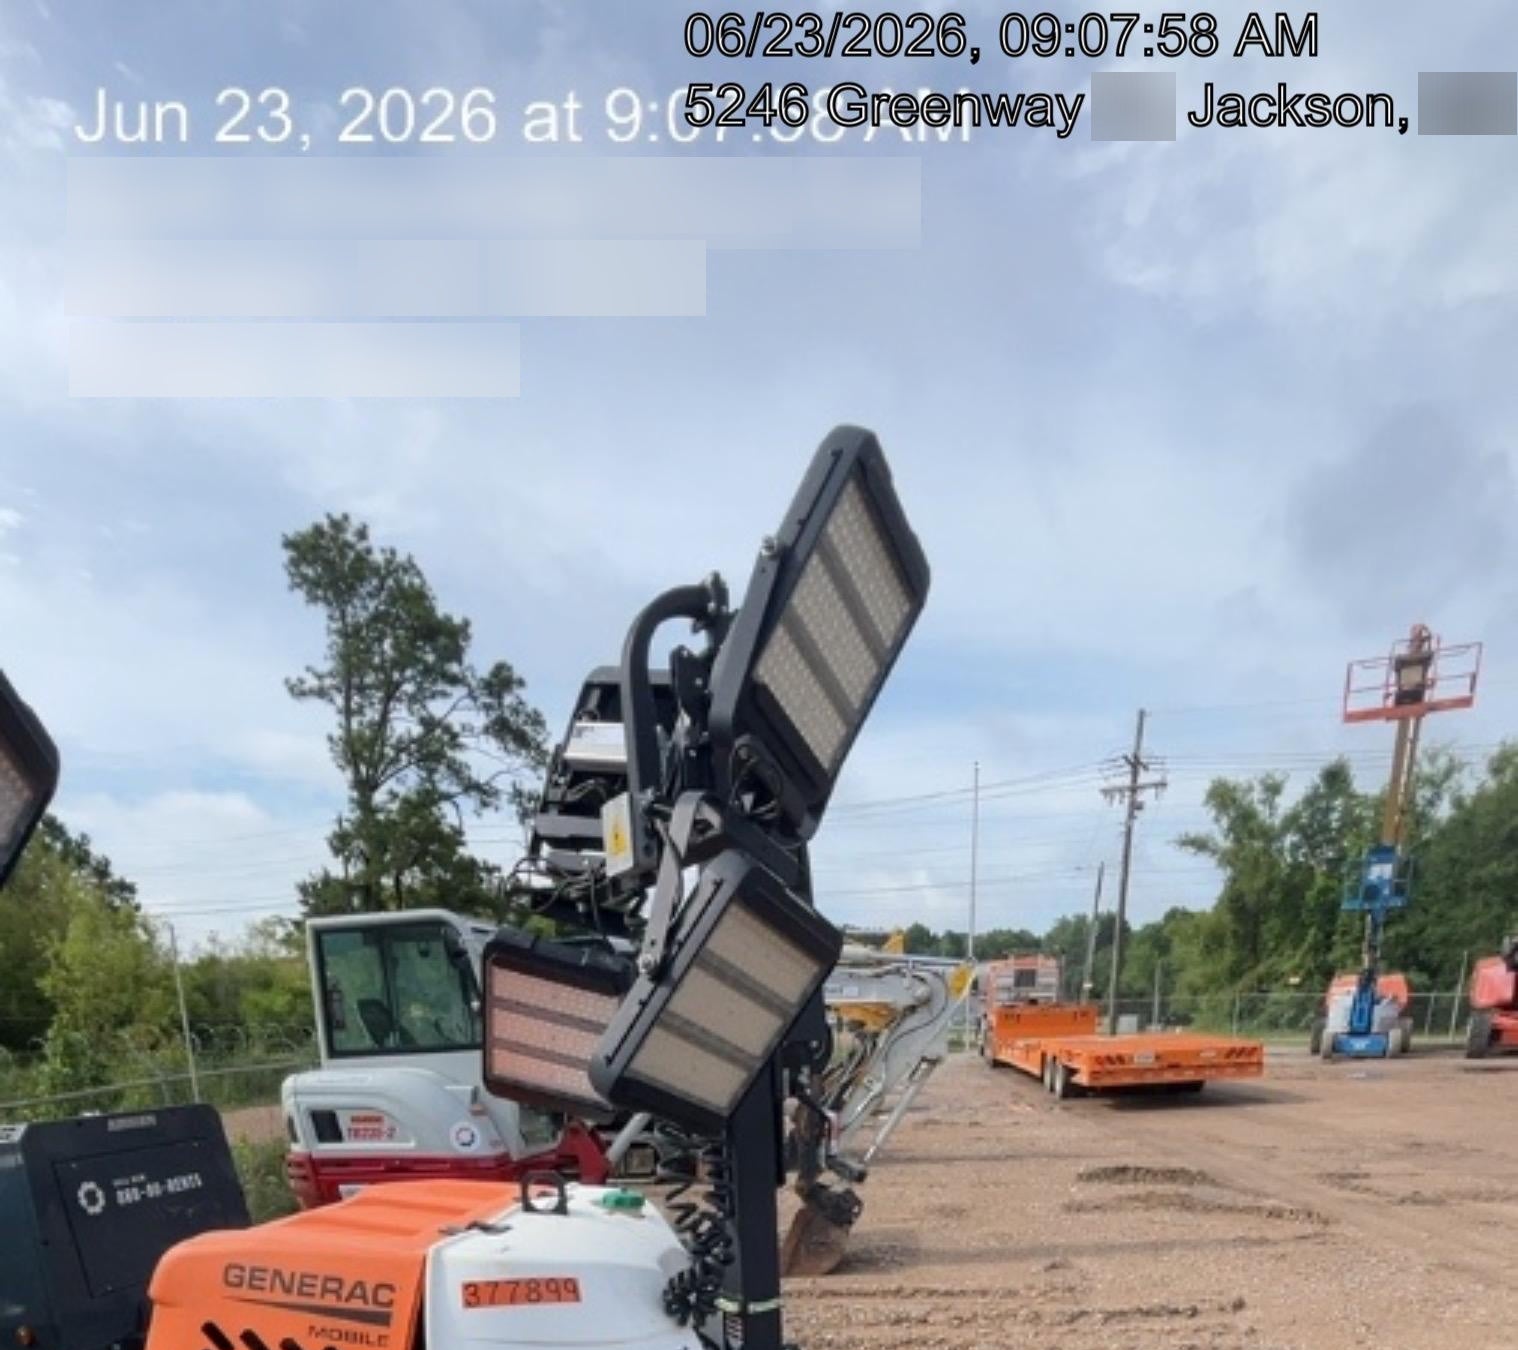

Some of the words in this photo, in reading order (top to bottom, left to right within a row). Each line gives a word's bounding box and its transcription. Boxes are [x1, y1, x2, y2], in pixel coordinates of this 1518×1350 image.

[223, 1263, 396, 1308] GENERAC
[464, 1278, 577, 1307] 377899
[308, 1325, 390, 1347] MOBILE
